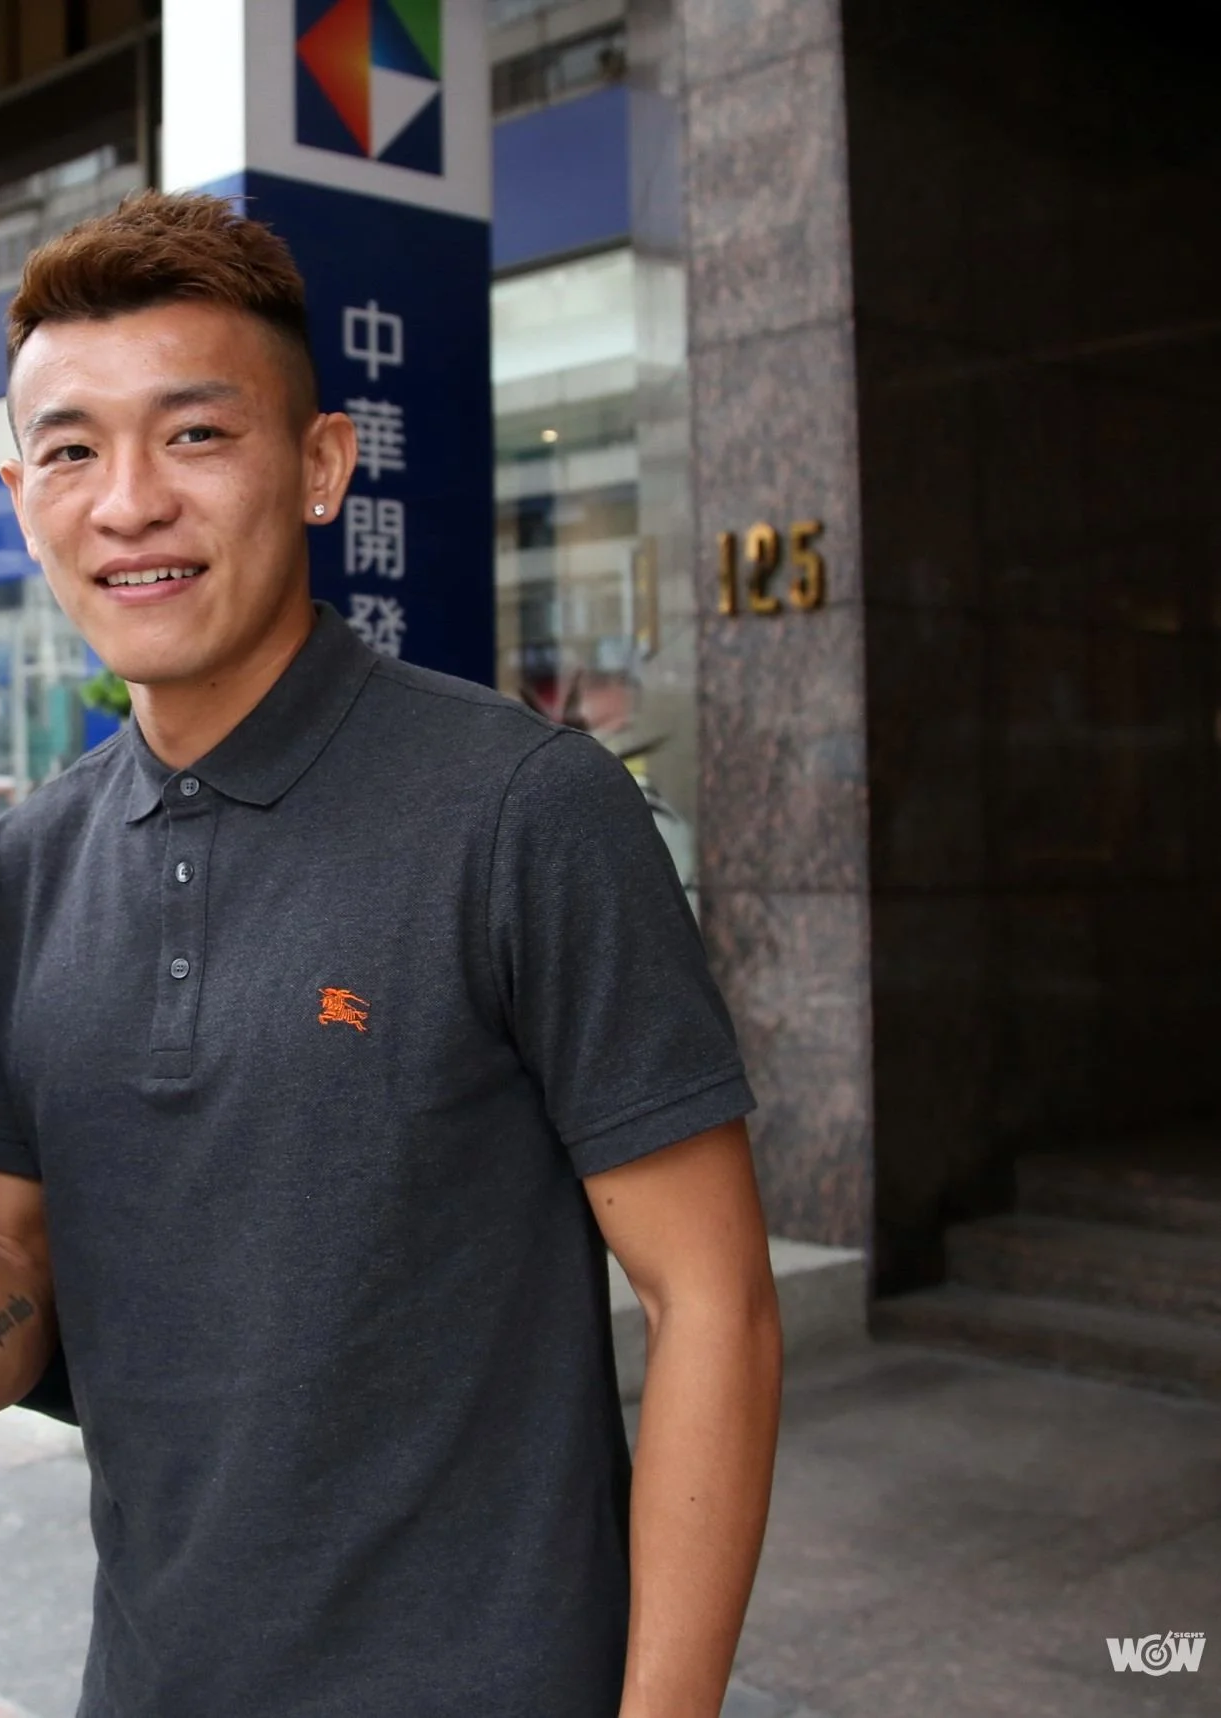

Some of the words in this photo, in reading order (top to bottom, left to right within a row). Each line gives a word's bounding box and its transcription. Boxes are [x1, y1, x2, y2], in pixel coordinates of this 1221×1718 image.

[343, 299, 407, 657] 中華開發
[717, 519, 824, 616] 125
